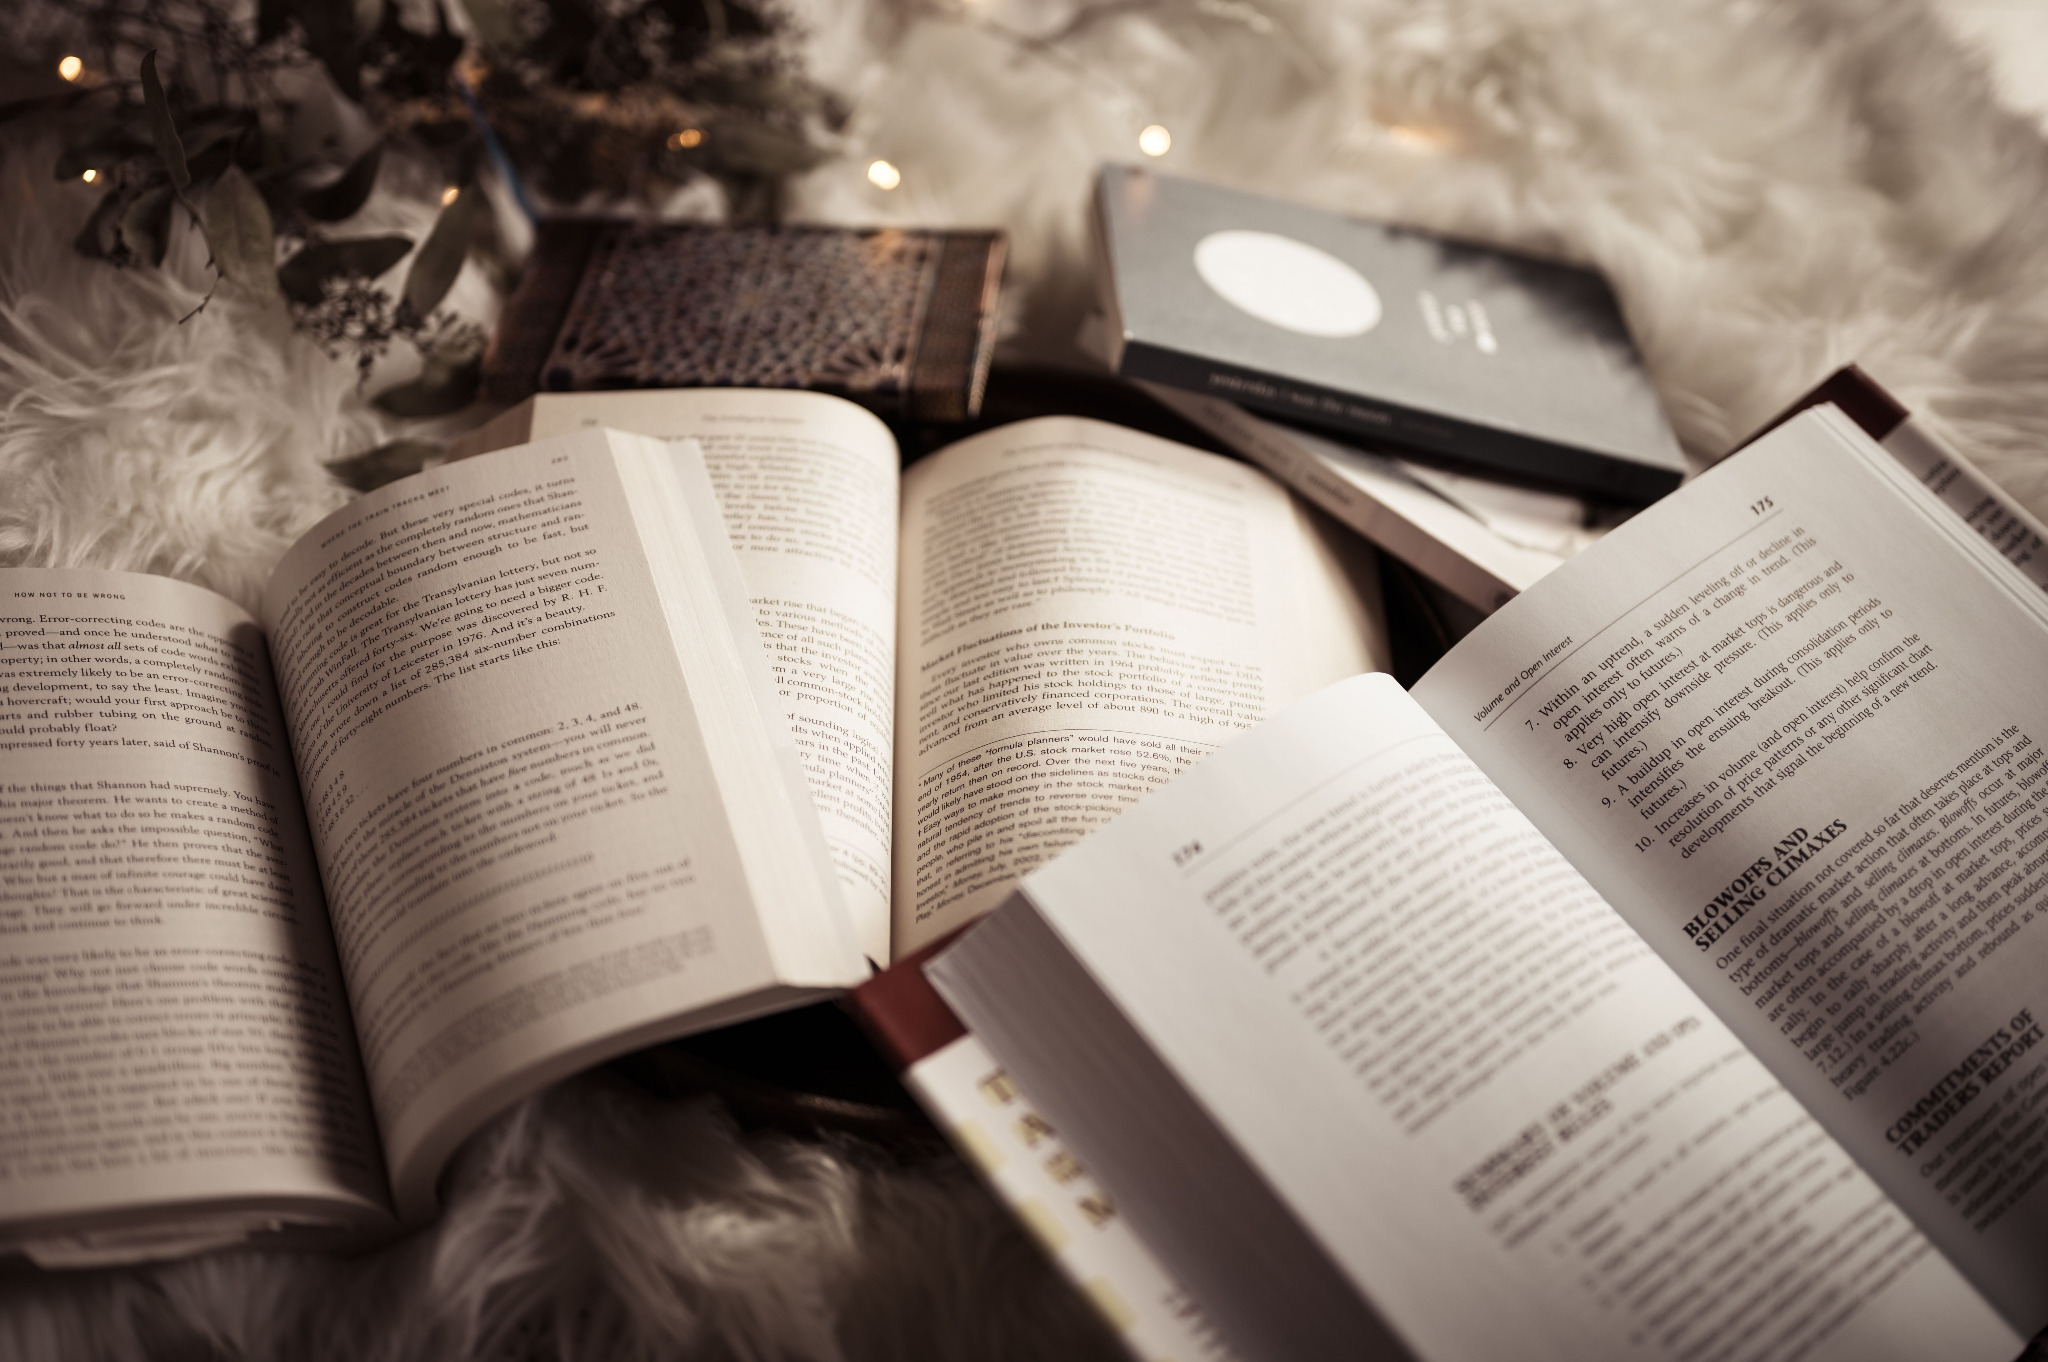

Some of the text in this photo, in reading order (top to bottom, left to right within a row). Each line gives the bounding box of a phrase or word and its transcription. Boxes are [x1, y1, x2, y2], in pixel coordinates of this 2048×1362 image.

[1750, 495, 1774, 515] 175
[13, 591, 36, 599] HOW
[38, 591, 57, 599] NOT
[60, 591, 73, 599] TO
[91, 592, 126, 601] WRONG
[39, 615, 133, 626] Error-correcting
[135, 619, 166, 629] codes
[188, 627, 204, 637] the
[350, 634, 358, 643] is
[360, 618, 383, 638] great
[385, 609, 400, 621] for
[402, 601, 420, 612] the
[421, 575, 496, 603] Transylvanian
[499, 564, 539, 578] lottery,
[541, 557, 560, 566] but
[564, 552, 581, 561] not
[41, 641, 65, 650] that
[68, 640, 104, 650] almost
[107, 641, 121, 650] all
[147, 645, 158, 653] of
[161, 648, 185, 656] code
[188, 653, 219, 666] words
[381, 669, 390, 682] of
[393, 649, 440, 675] Leicester
[443, 644, 453, 652] in
[458, 631, 487, 646] 1976.
[491, 621, 514, 636] And
[545, 606, 584, 620] beauty.
[390, 679, 407, 691] list
[410, 668, 421, 681] of
[424, 650, 469, 674] 285,384
[474, 631, 536, 655] six-number
[541, 612, 616, 634] combinations
[920, 649, 955, 673] Market
[956, 628, 1024, 655] Fluctuations
[1025, 623, 1039, 634] of
[1040, 621, 1060, 631] the
[1124, 623, 1176, 641] Portfolio
[1525, 527, 1805, 731] 7. Within an uptrend, a sudden leveling off or decline in
[18, 668, 78, 678] extremely
[81, 668, 112, 679] likely
[129, 669, 143, 678] be
[162, 674, 243, 702] error-correcting
[1473, 636, 1573, 722] Volume and Open Interest
[1563, 560, 1843, 769] 8. Very high open interest at market tops is dangerous and
[7, 696, 71, 706] hovercraft;
[75, 695, 112, 704] would
[114, 698, 140, 706] your
[144, 696, 167, 707] first
[170, 702, 219, 715] approach
[220, 708, 233, 719] be
[778, 689, 867, 722] or proportion of
[918, 727, 960, 756] advanced
[964, 718, 988, 732] from
[991, 713, 1004, 722] an
[1008, 705, 1052, 717] average
[1056, 701, 1083, 709] level
[1103, 702, 1135, 712] about
[1140, 706, 1159, 714] 890
[1189, 713, 1214, 724] high
[917, 787, 932, 802] end
[934, 780, 943, 792] of
[946, 770, 970, 785] 1954,
[973, 761, 993, 773] after
[997, 755, 1012, 765] the
[1015, 749, 1036, 759] U.S.
[1040, 747, 1067, 755] stock
[1136, 750, 1172, 763] 52.6%,
[1176, 756, 1192, 765] the
[923, 771, 944, 787] Many
[946, 763, 955, 774] of
[958, 754, 982, 768] these
[1078, 735, 1109, 743] would
[1113, 736, 1136, 745] have
[1140, 741, 1161, 749] sold
[1165, 743, 1176, 751] all
[1180, 746, 1202, 755] their
[1635, 634, 1920, 853] 10. Increases in volume (and open interest) help confirm the
[1682, 828, 1808, 939] BLOWOFFS AND
[1695, 819, 1847, 952] SELLING CLIMAXES
[1885, 1008, 2033, 1143] COMMITMENTS OF
[1898, 1023, 2045, 1156] TRADERS REPORT
